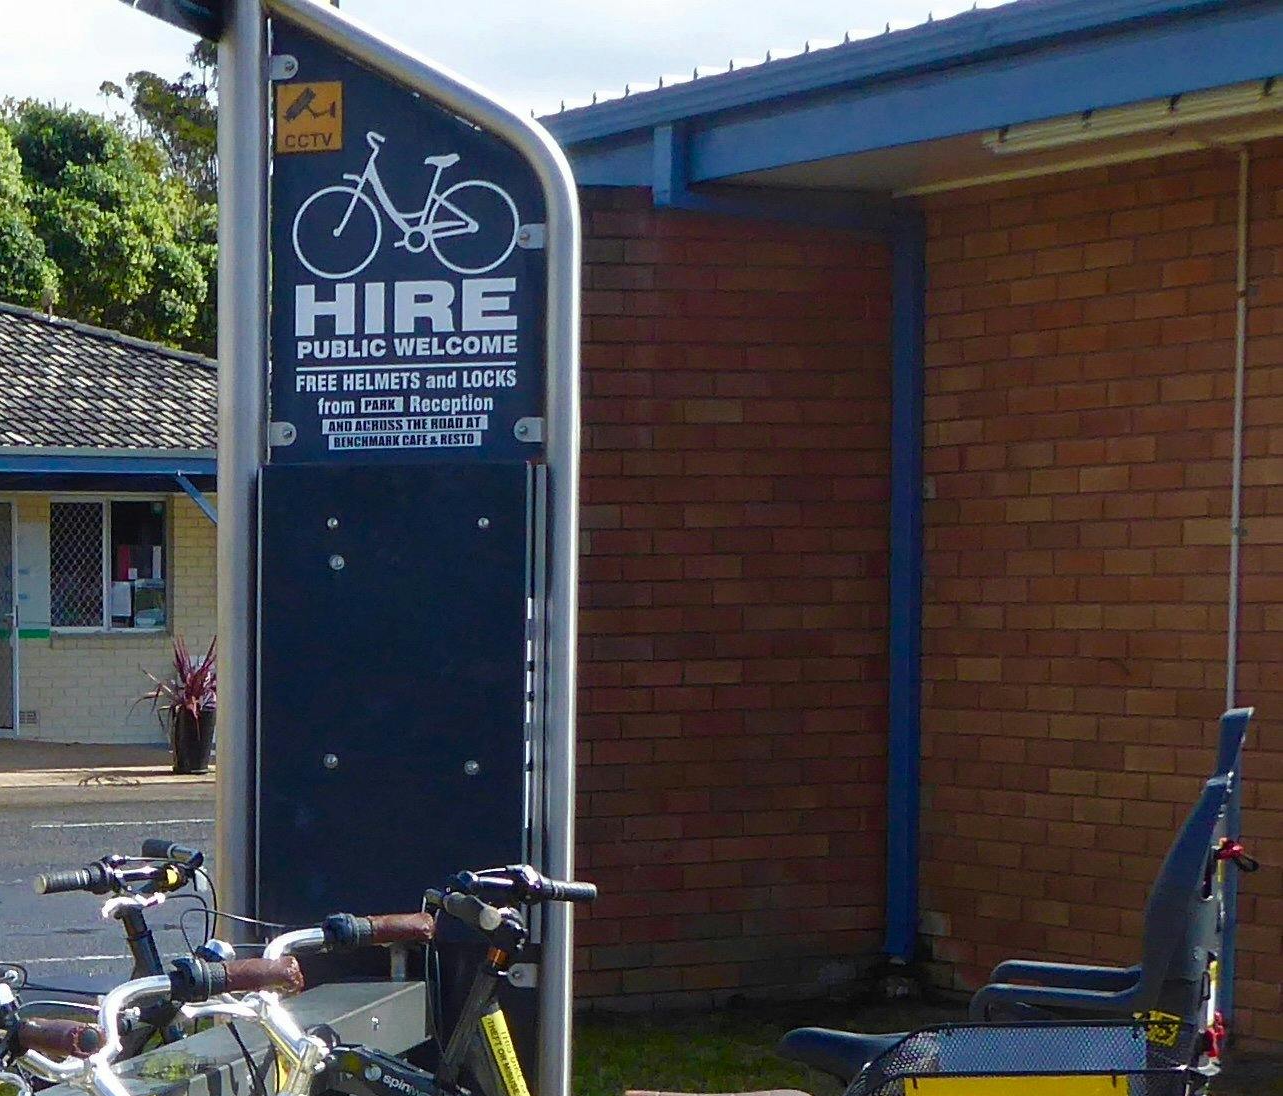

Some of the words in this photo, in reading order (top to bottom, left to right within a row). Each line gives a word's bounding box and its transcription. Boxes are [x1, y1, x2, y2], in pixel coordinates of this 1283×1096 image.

[284, 133, 332, 147] CCTV
[295, 277, 518, 337] HIRE
[297, 338, 386, 359] PUBLIC
[394, 335, 518, 357] WELCOME
[296, 374, 337, 392] FREE
[343, 372, 420, 391] HELMETS
[426, 371, 456, 389] and
[463, 369, 516, 388] LOCKS
[318, 397, 355, 415] from
[364, 399, 396, 412] PARK
[409, 394, 494, 414] Reception
[328, 420, 352, 432] AND
[355, 419, 403, 432] ACROSS
[407, 418, 427, 430] THE
[430, 417, 462, 430] ROAD
[466, 416, 481, 429] AT
[333, 435, 400, 448] BENCHMARK
[402, 434, 428, 446] CAFE
[441, 433, 474, 445] RESTO
